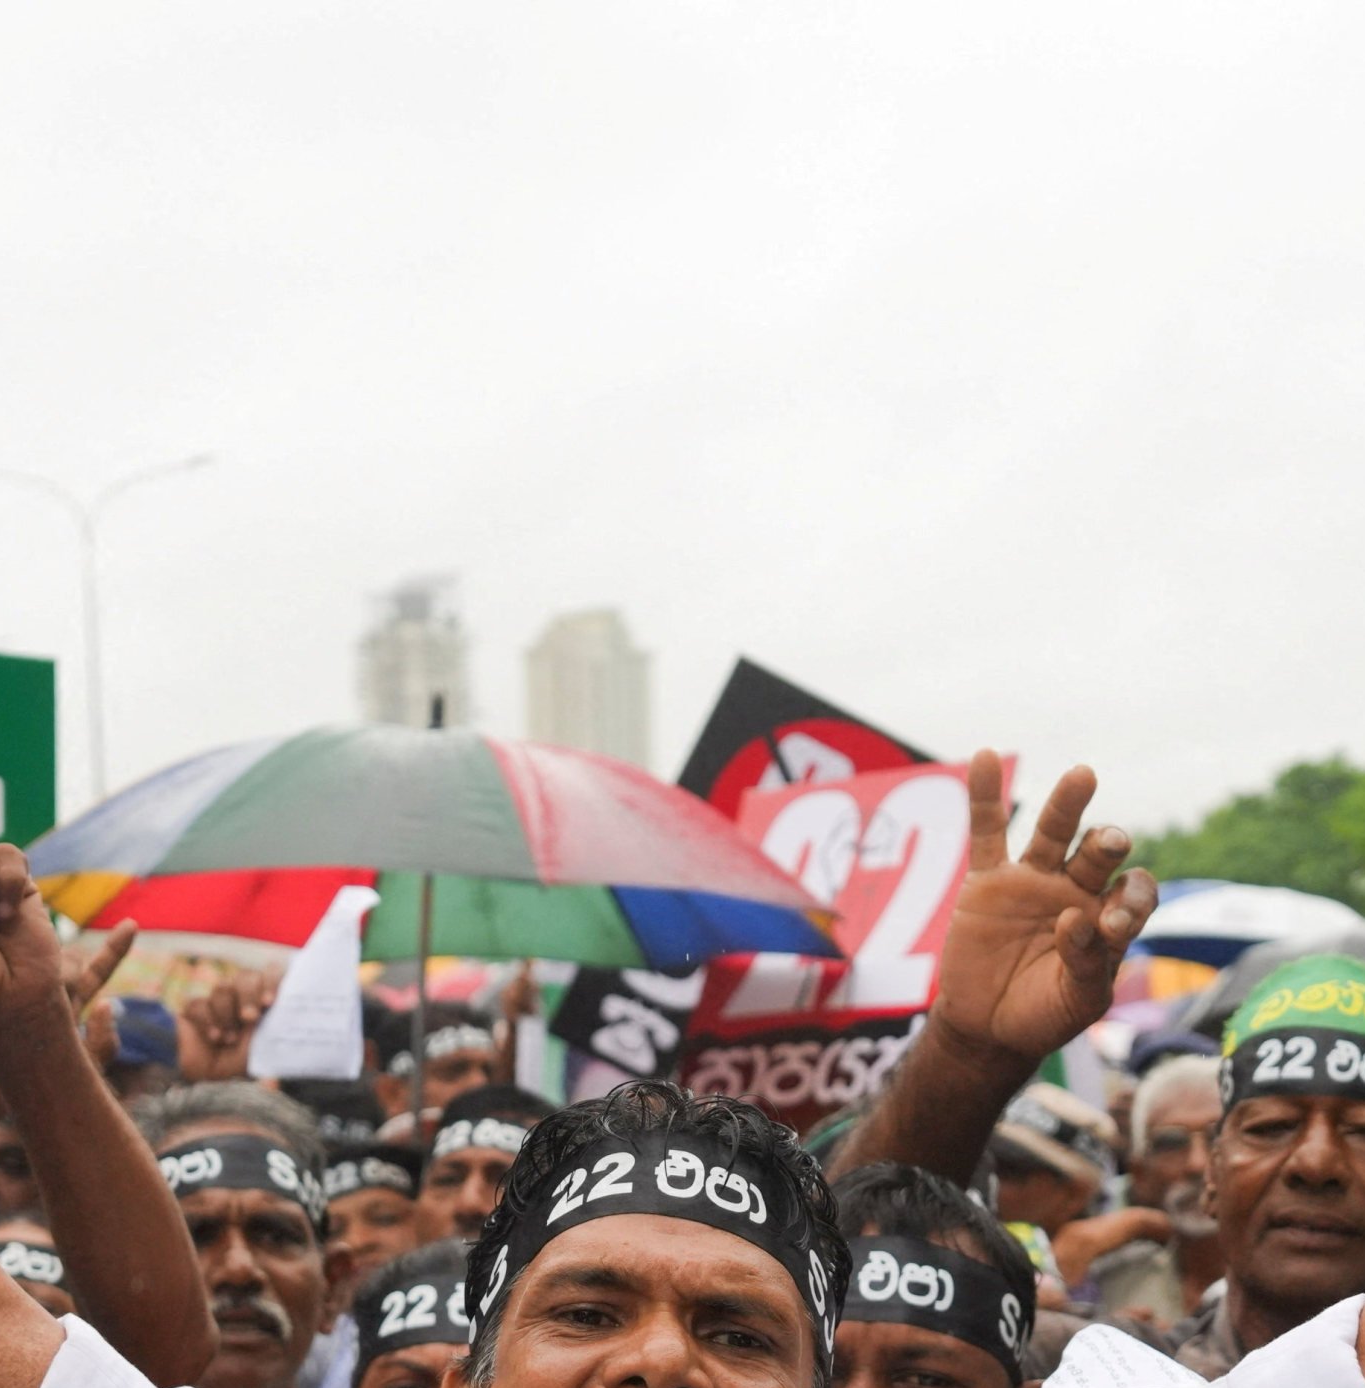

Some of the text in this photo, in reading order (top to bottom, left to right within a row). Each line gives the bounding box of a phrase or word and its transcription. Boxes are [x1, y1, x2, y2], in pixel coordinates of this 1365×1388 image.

[1252, 1035, 1317, 1083] 22
[546, 1152, 635, 1226] 22
[655, 1149, 767, 1224] එපා
[858, 1250, 955, 1311] එපා
[377, 1284, 438, 1338] 22
